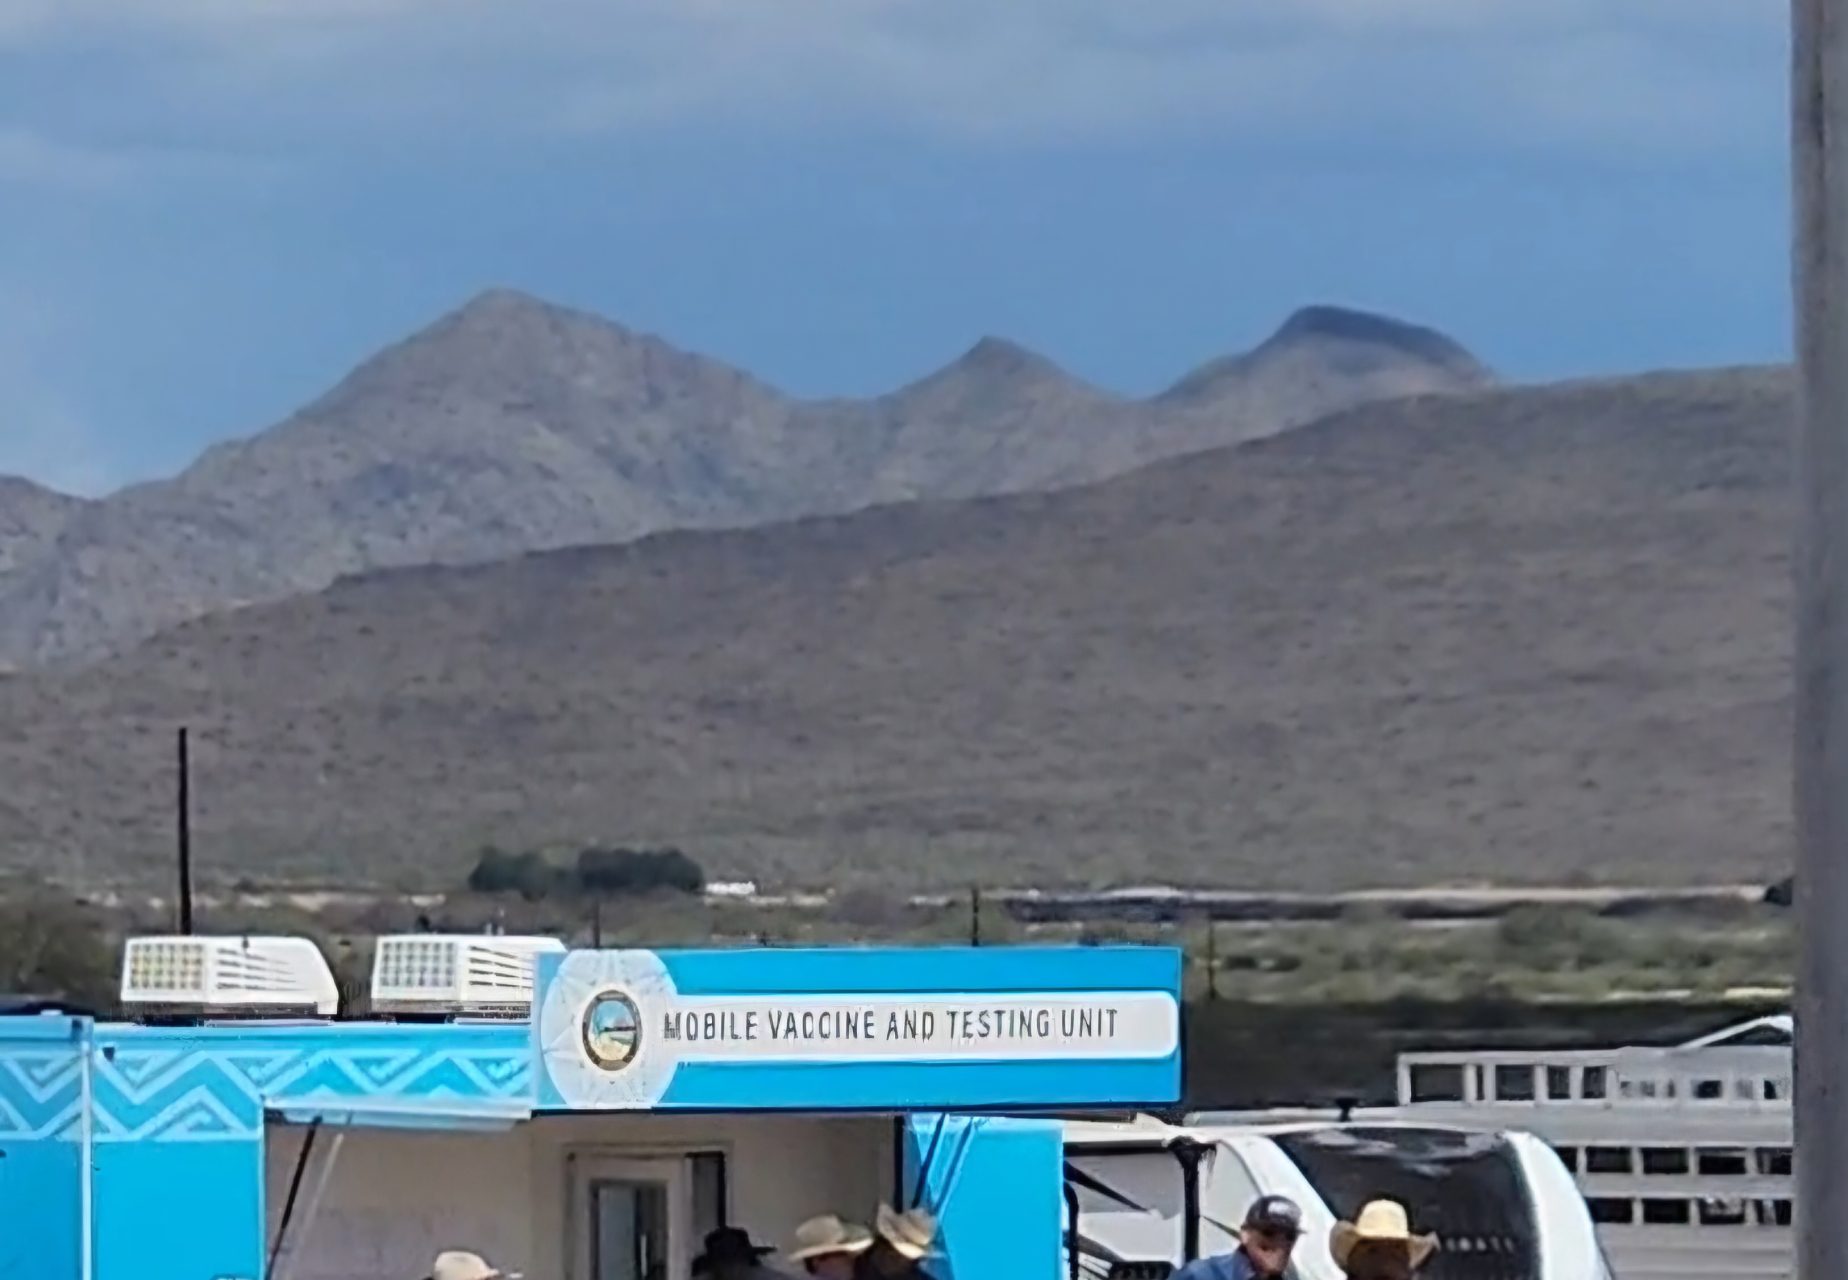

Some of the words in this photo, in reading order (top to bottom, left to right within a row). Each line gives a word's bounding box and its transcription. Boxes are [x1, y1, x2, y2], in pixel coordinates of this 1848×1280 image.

[664, 1011, 757, 1040] MOBILE
[768, 1010, 875, 1040] VACCINE
[886, 1009, 934, 1041] AND
[947, 1009, 1049, 1039] TESTING
[1061, 1008, 1118, 1038] UNIT
